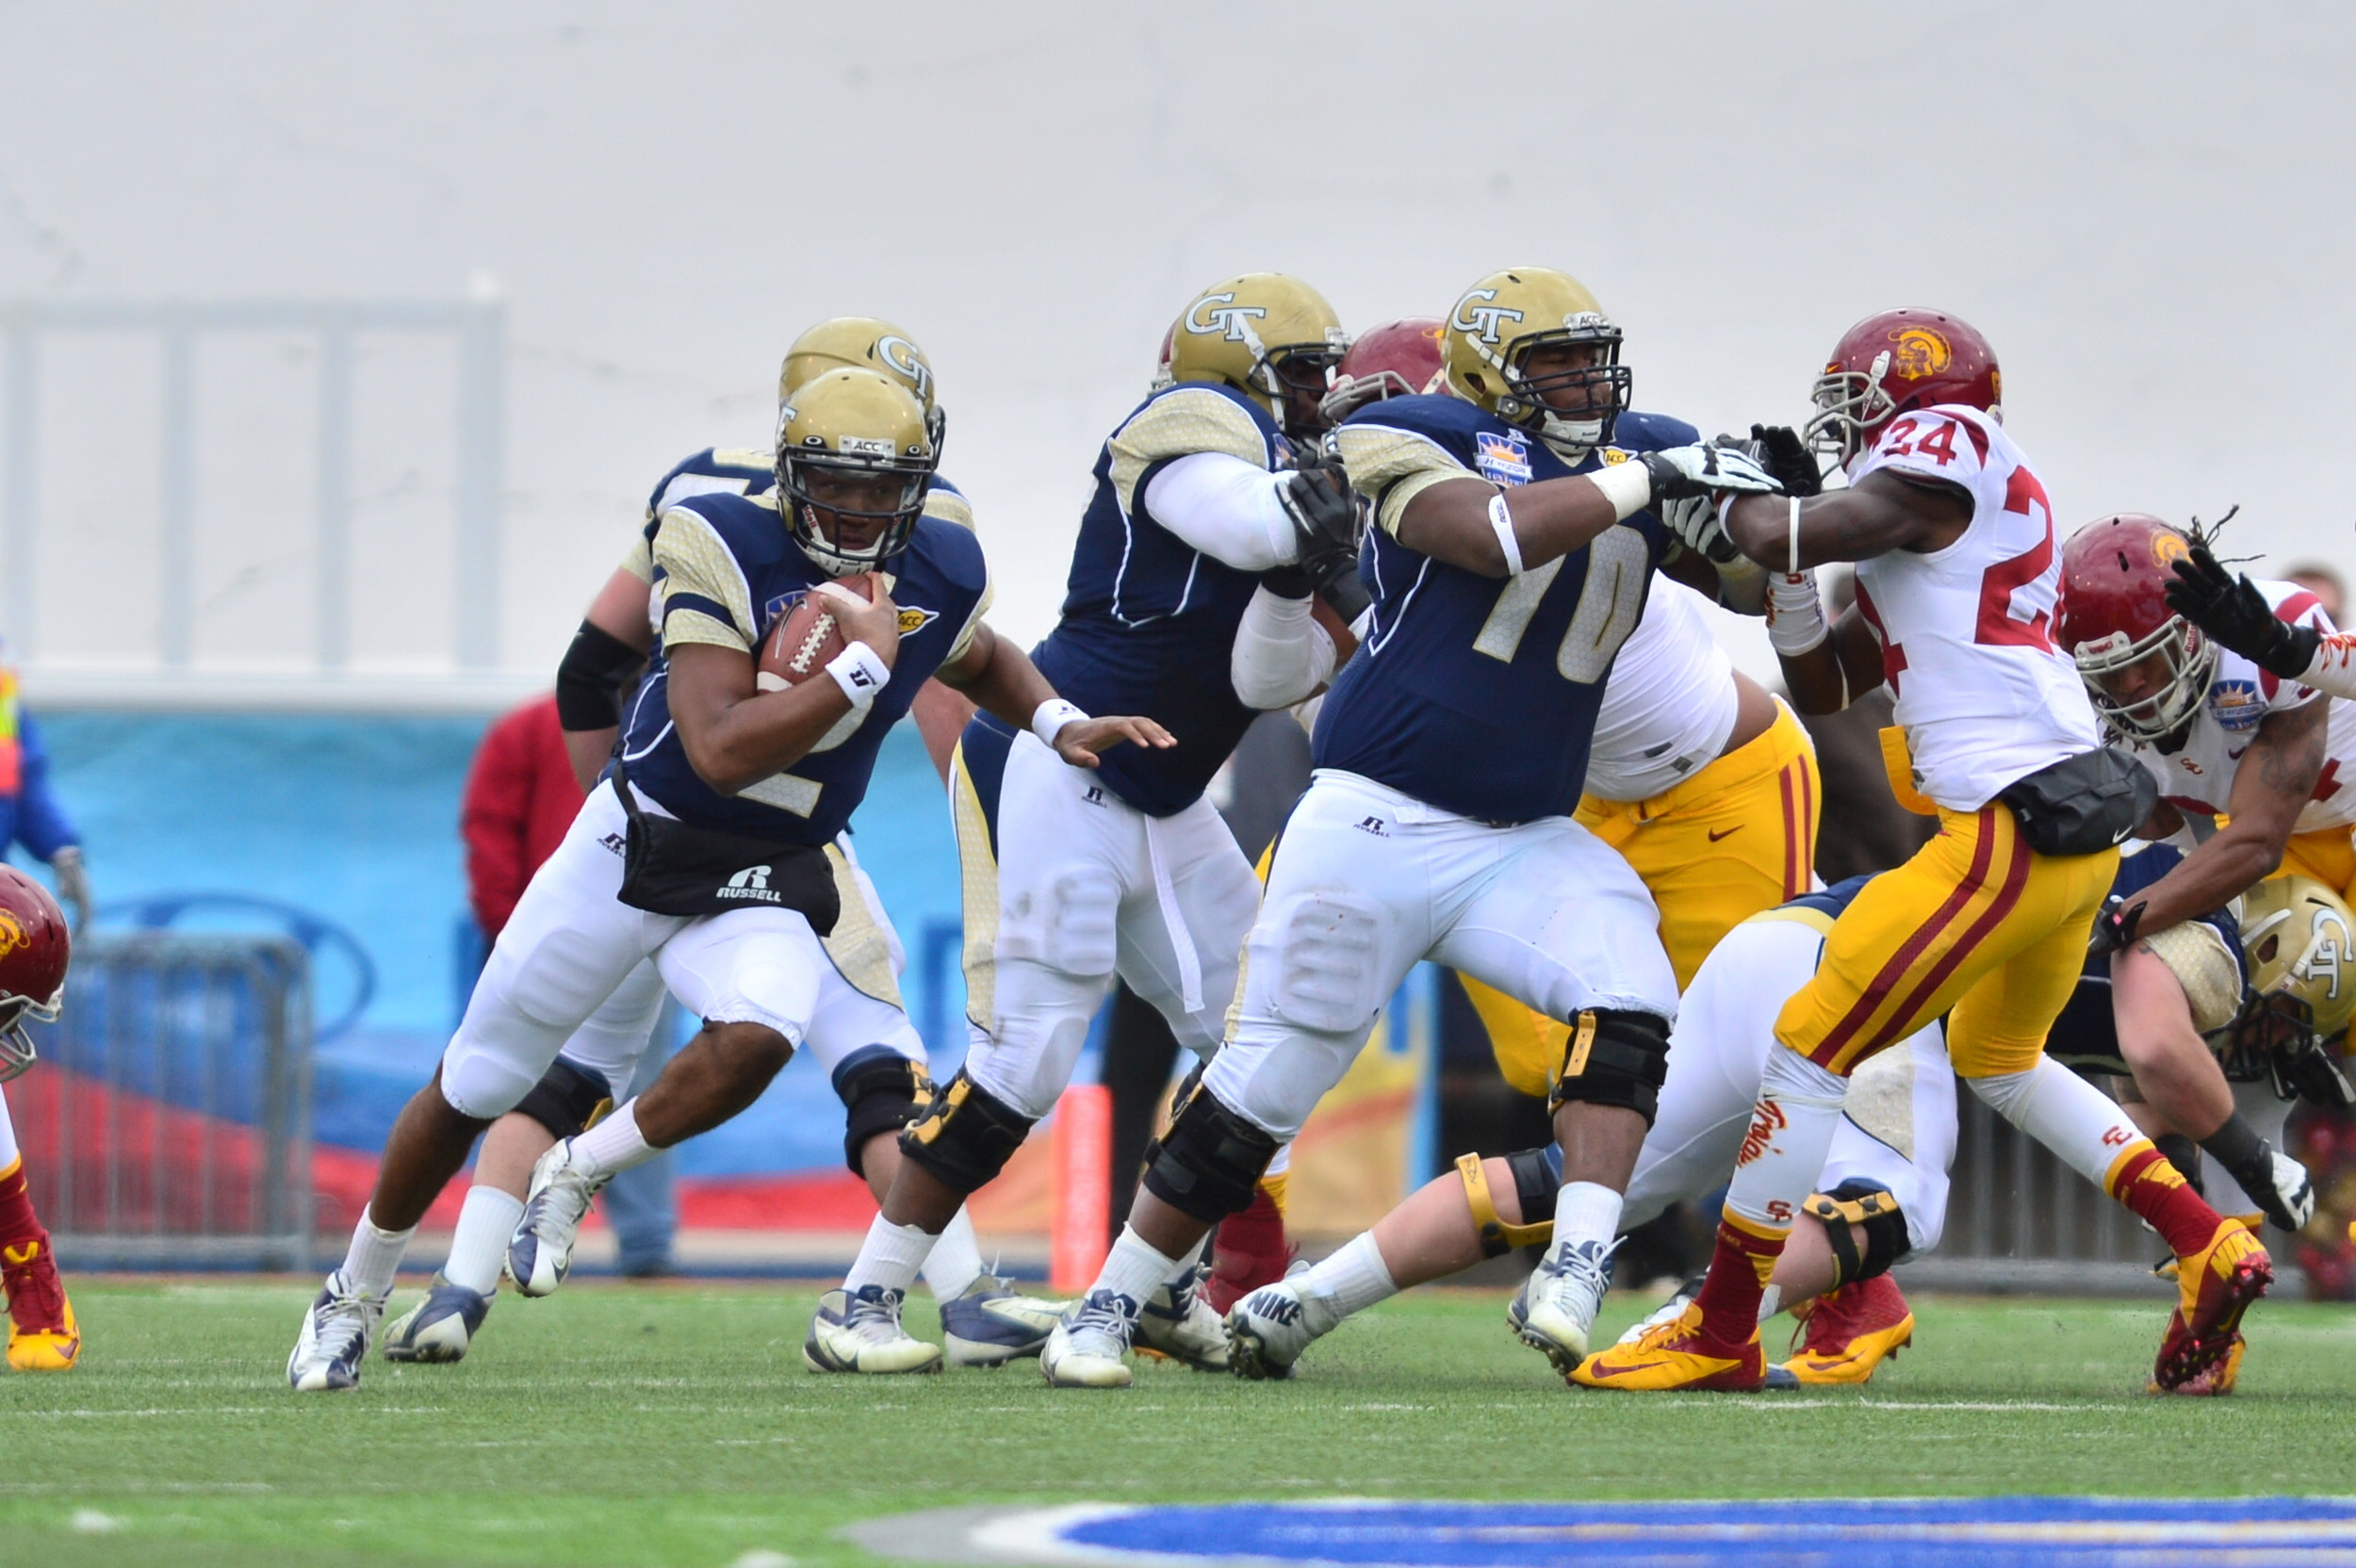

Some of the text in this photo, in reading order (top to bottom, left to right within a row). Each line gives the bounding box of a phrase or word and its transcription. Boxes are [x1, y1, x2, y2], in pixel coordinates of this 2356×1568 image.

[1185, 292, 1267, 342] GT
[1452, 289, 1525, 344] GT
[877, 335, 935, 400] GT
[853, 441, 881, 452] ACC
[1882, 417, 1957, 466] 24
[898, 615, 922, 627] ACC
[1472, 524, 1649, 685] 70
[716, 887, 782, 903] RUSSELL
[728, 864, 773, 889] R
[1247, 1290, 1301, 1328] NIKE
